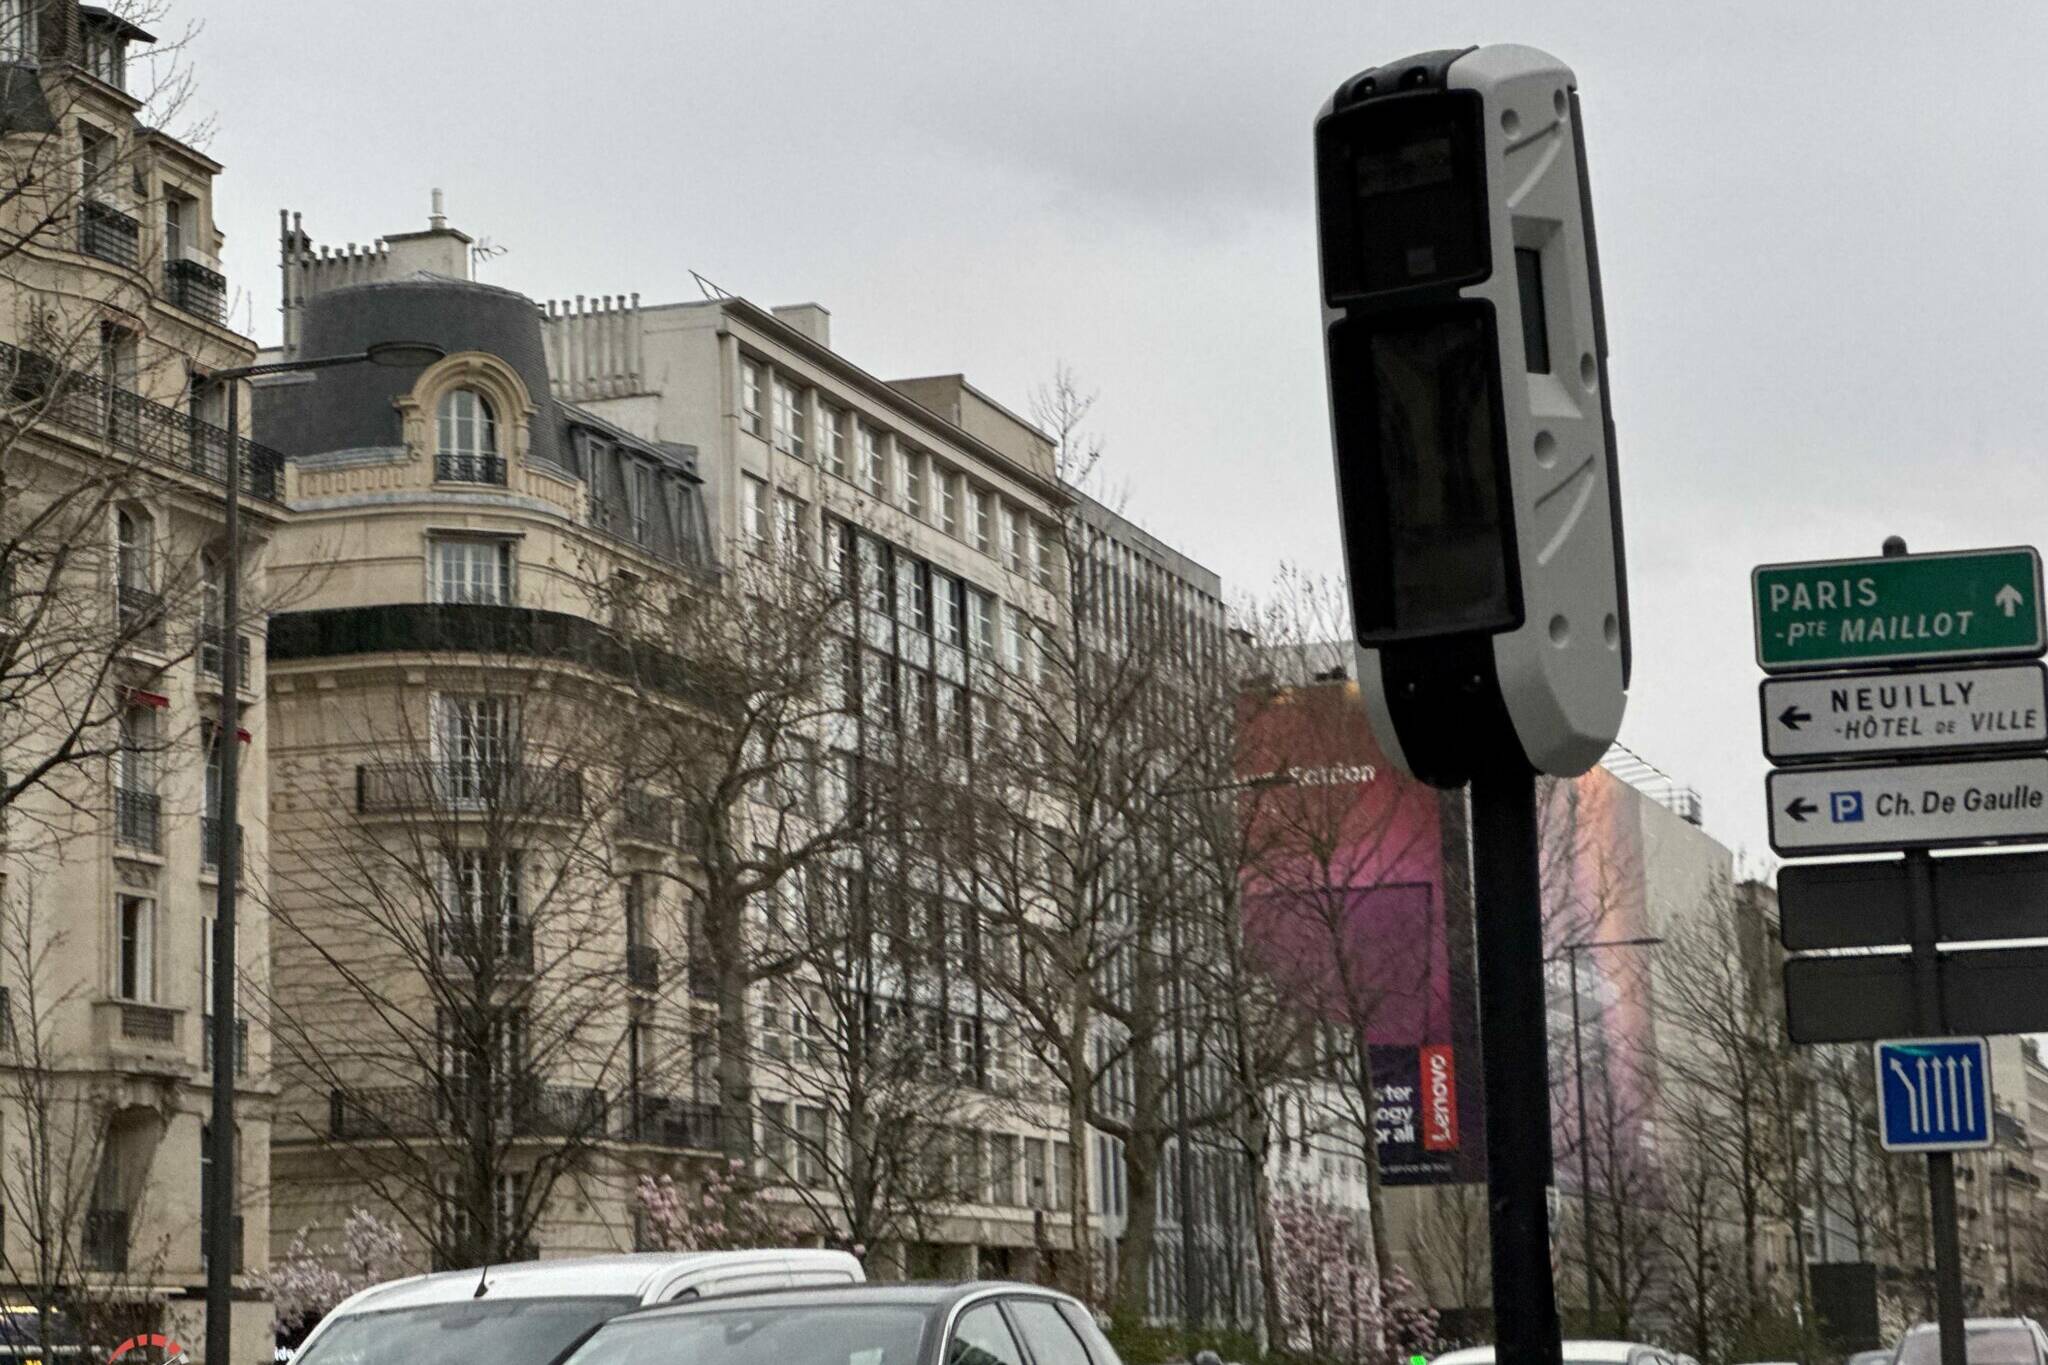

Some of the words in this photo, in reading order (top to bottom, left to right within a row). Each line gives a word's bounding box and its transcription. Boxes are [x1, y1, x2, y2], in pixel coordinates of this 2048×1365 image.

[1770, 578, 1878, 612] PARIS
[1840, 611, 1974, 643] MAILLOT
[1831, 681, 1974, 713] NEUILLY
[1971, 709, 2037, 732] VILLE
[1836, 794, 1858, 821] P
[1876, 792, 1915, 817] Ch.
[1921, 790, 1957, 814] De
[1963, 785, 2044, 812] Gaulle
[1430, 1054, 1451, 1141] Lenovo
